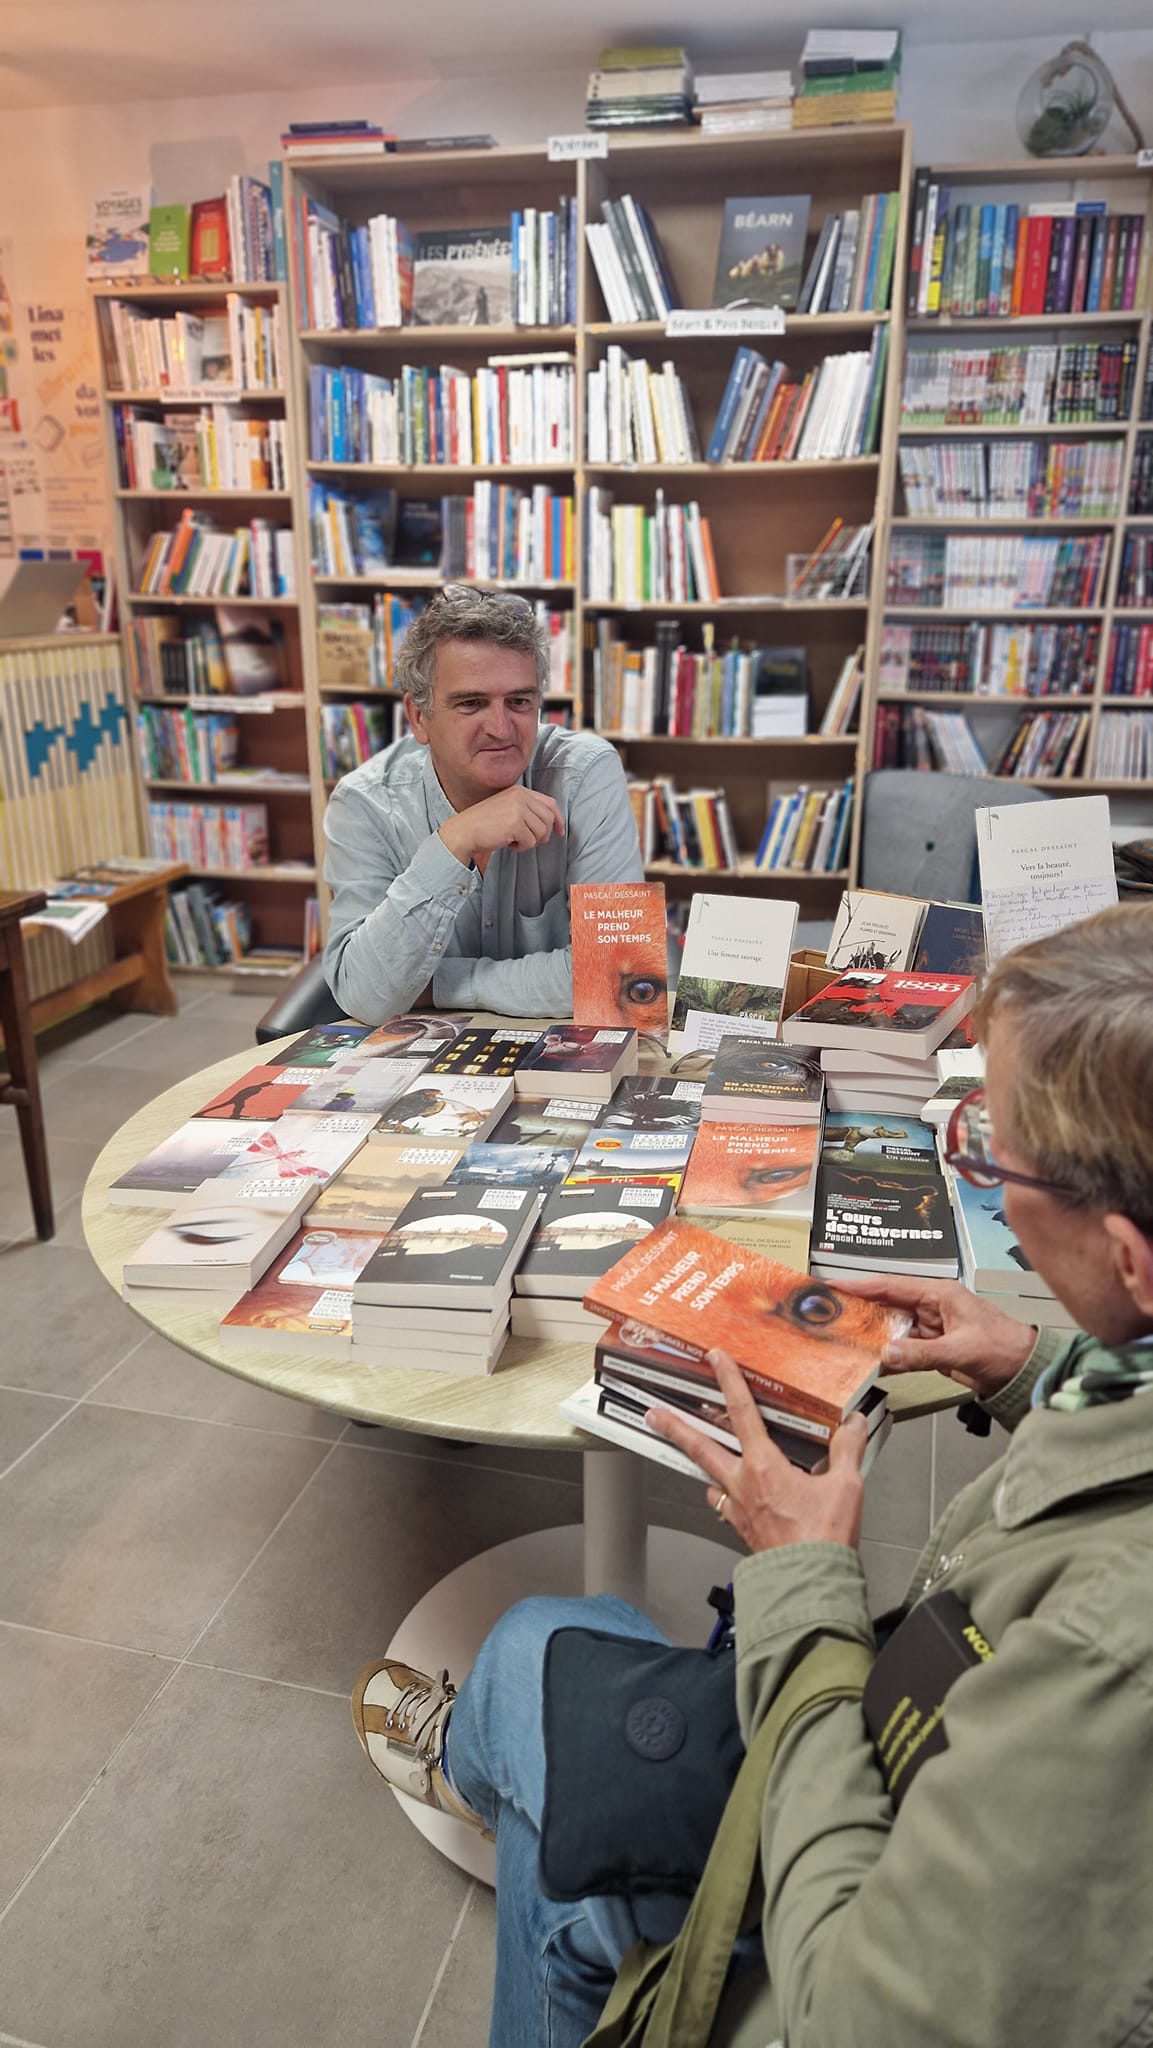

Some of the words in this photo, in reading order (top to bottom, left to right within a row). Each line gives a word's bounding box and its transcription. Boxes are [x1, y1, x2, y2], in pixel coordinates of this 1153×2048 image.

[95, 198, 142, 211] VOYAGES
[734, 211, 793, 229] BÉARN
[420, 245, 445, 261] LES
[1041, 843, 1078, 851] DESSAINT
[1020, 863, 1036, 871] Vers
[1045, 860, 1072, 869] beauté,
[583, 892, 613, 900] PASCAL
[614, 890, 651, 899] DESSAINT
[584, 911, 595, 920] LE
[597, 909, 643, 919] MALHEUR
[597, 922, 630, 931] PREND
[597, 935, 618, 944] SON
[620, 934, 652, 943] TEMPS
[707, 949, 719, 957] Une
[720, 950, 740, 960] femme
[740, 953, 762, 962] sauvage
[893, 979, 962, 992] 1886
[739, 1011, 766, 1021] PASCAL
[723, 1086, 782, 1094] BUKOWSKI
[741, 1082, 806, 1093] ATTENDANT
[885, 1149, 921, 1157] DESSAINT
[899, 1155, 930, 1163] colosse
[610, 1176, 634, 1184] Prix
[825, 1208, 883, 1226] L'ours
[825, 1220, 859, 1236] des
[860, 1224, 944, 1240] tavernes
[824, 1232, 854, 1244] Pascal
[855, 1235, 895, 1248] Dessaint
[611, 1261, 645, 1292] PASCAL
[640, 1230, 680, 1264] DESSAINT
[638, 1289, 660, 1307] LE
[654, 1250, 703, 1296] MALHEUR
[670, 1270, 708, 1303] PREND
[689, 1286, 719, 1312] SON
[710, 1260, 746, 1291] TEMPS
[684, 1343, 705, 1358] SON
[771, 1381, 784, 1393] LE
